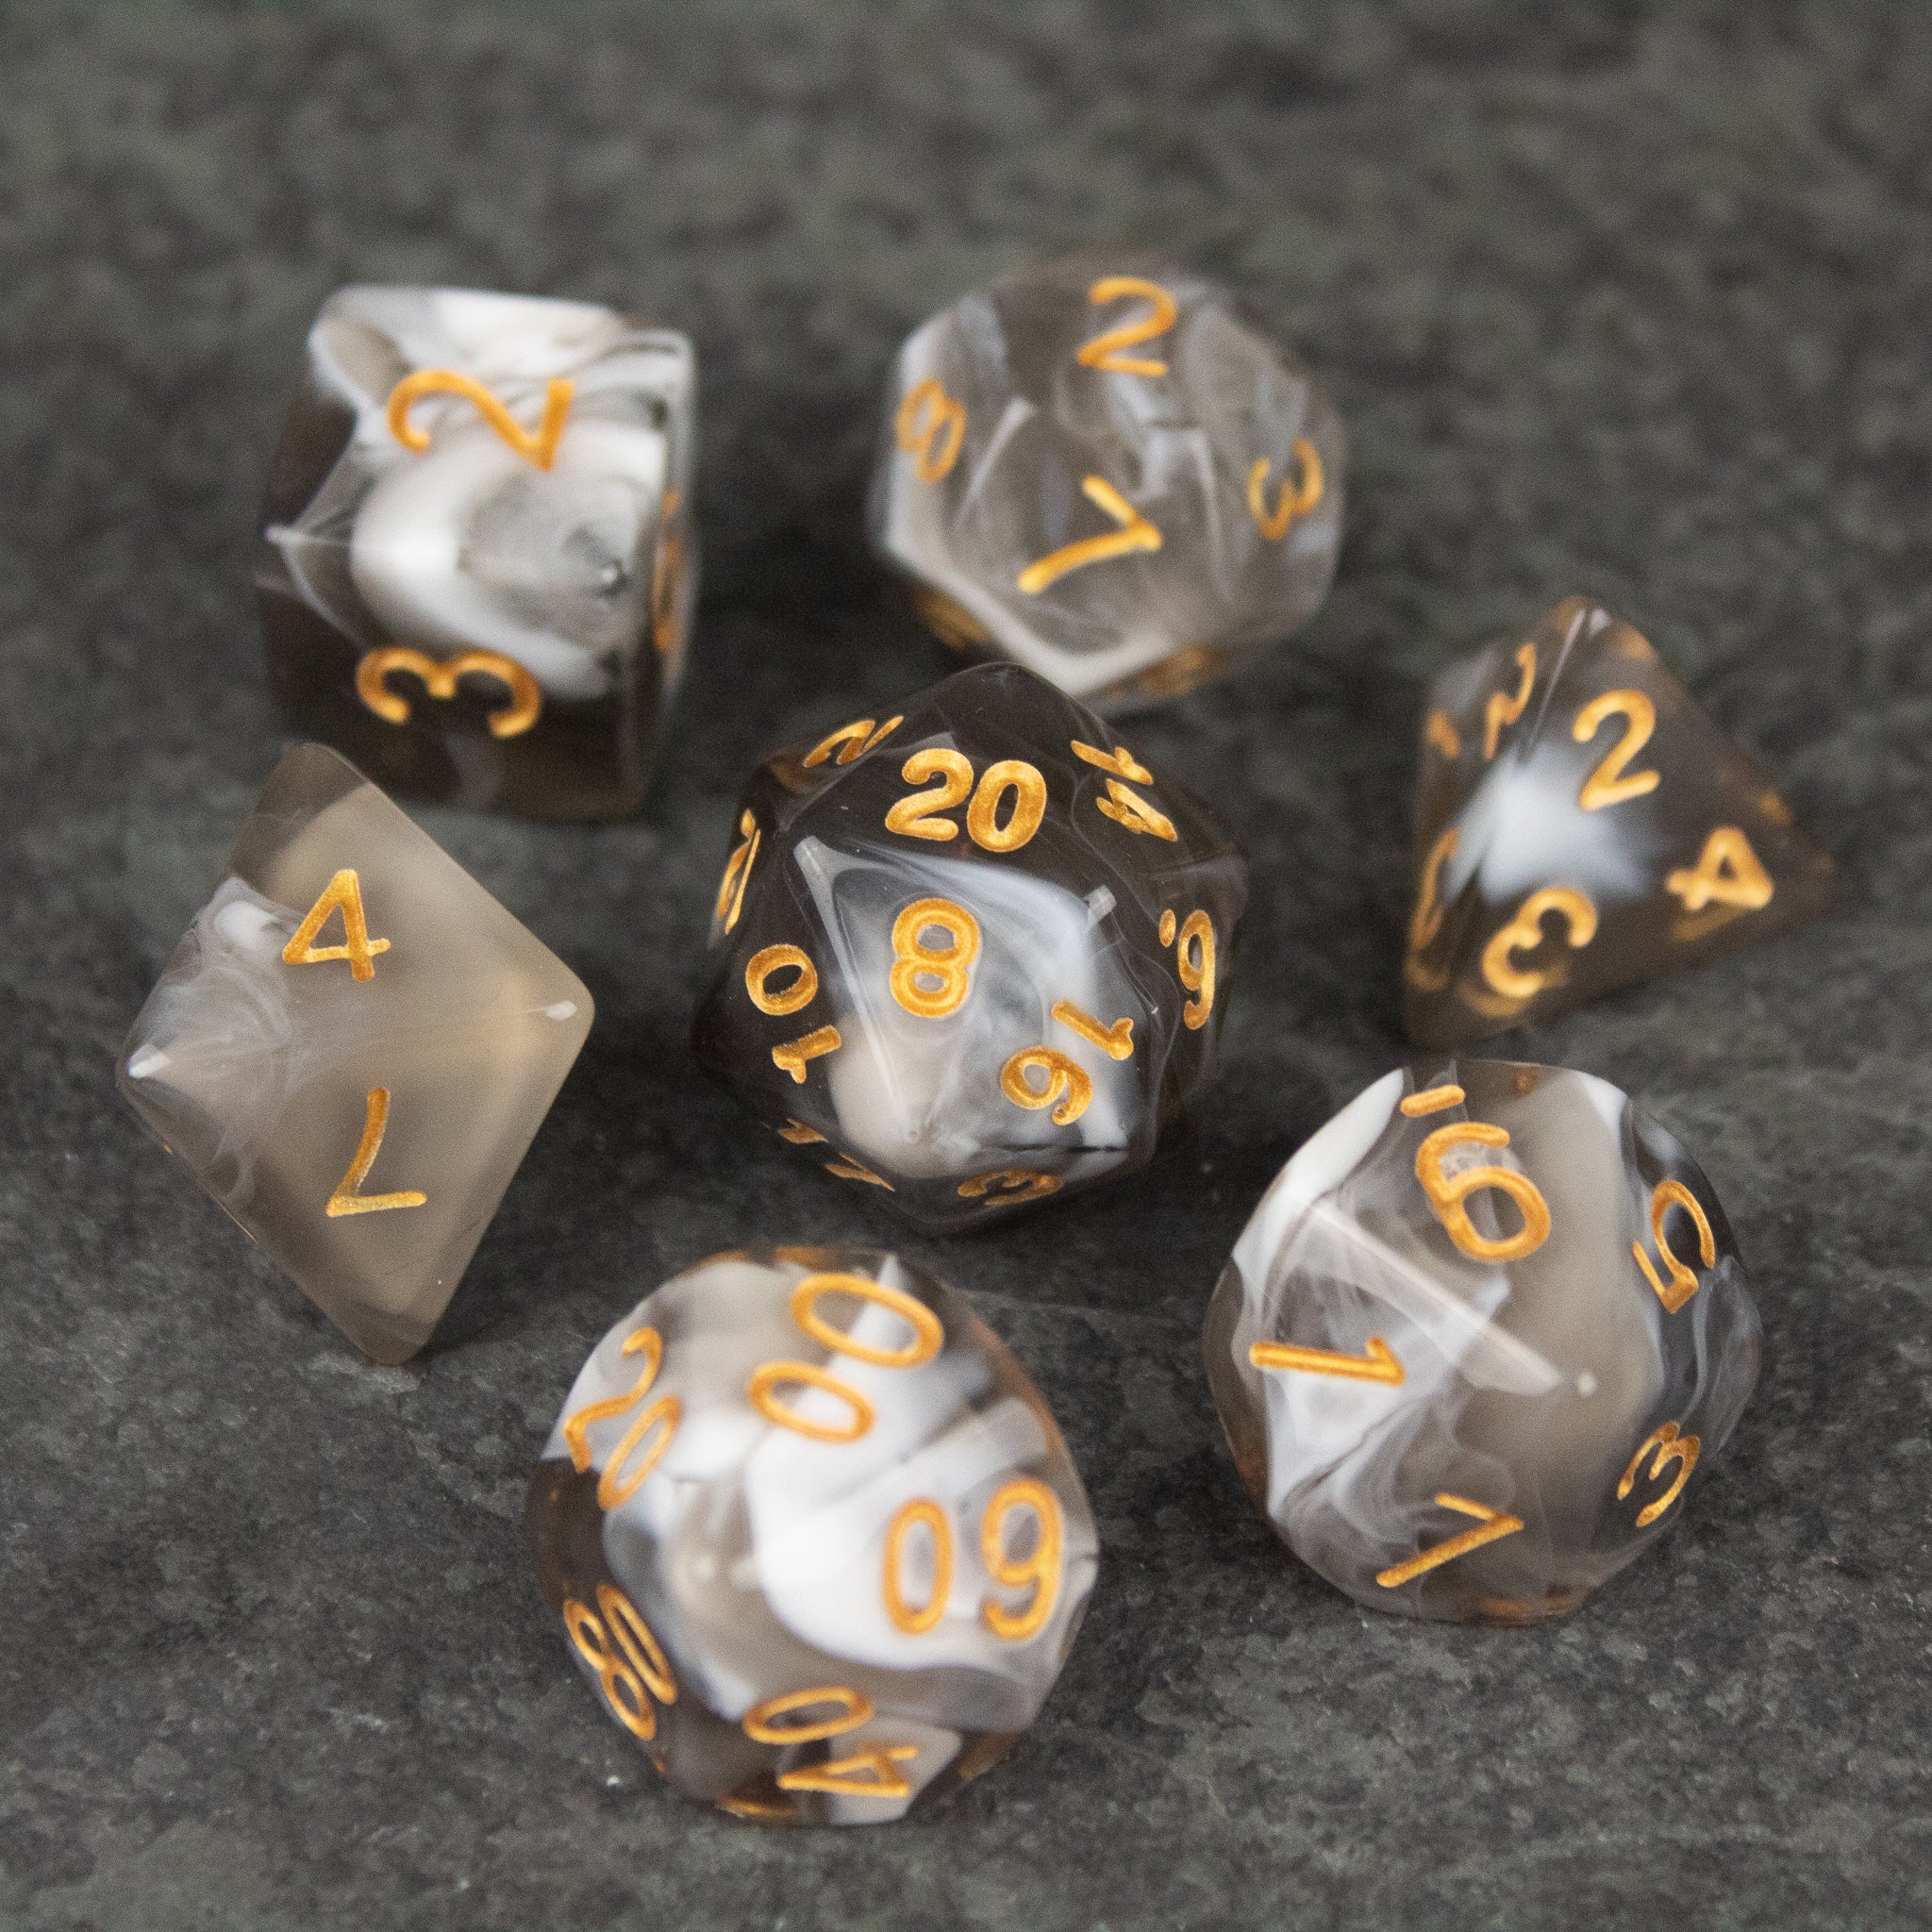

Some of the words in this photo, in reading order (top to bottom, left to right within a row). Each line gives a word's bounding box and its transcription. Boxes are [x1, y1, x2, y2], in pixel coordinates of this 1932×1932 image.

[1076, 277, 1177, 377] 2
[386, 369, 575, 472] 2
[897, 378, 966, 482] 8
[1248, 441, 1323, 539] 3
[358, 647, 540, 738] 3
[805, 716, 903, 766] 2
[885, 748, 1048, 853] 20
[1573, 689, 1658, 809] 2
[1668, 827, 1773, 910] 4
[281, 870, 391, 982] 4
[889, 897, 980, 1019] 8
[1482, 887, 1597, 998] 3
[744, 944, 842, 1083] 10
[1000, 1000, 1135, 1125] 16
[325, 1087, 427, 1218] 7
[1632, 1180, 1715, 1312] 5
[746, 1271, 943, 1443] 00
[1249, 1336, 1406, 1387] 1
[562, 1326, 682, 1509] 20
[1617, 1424, 1699, 1526] 3
[1376, 1492, 1524, 1588] 7
[564, 1586, 676, 1740] 80
